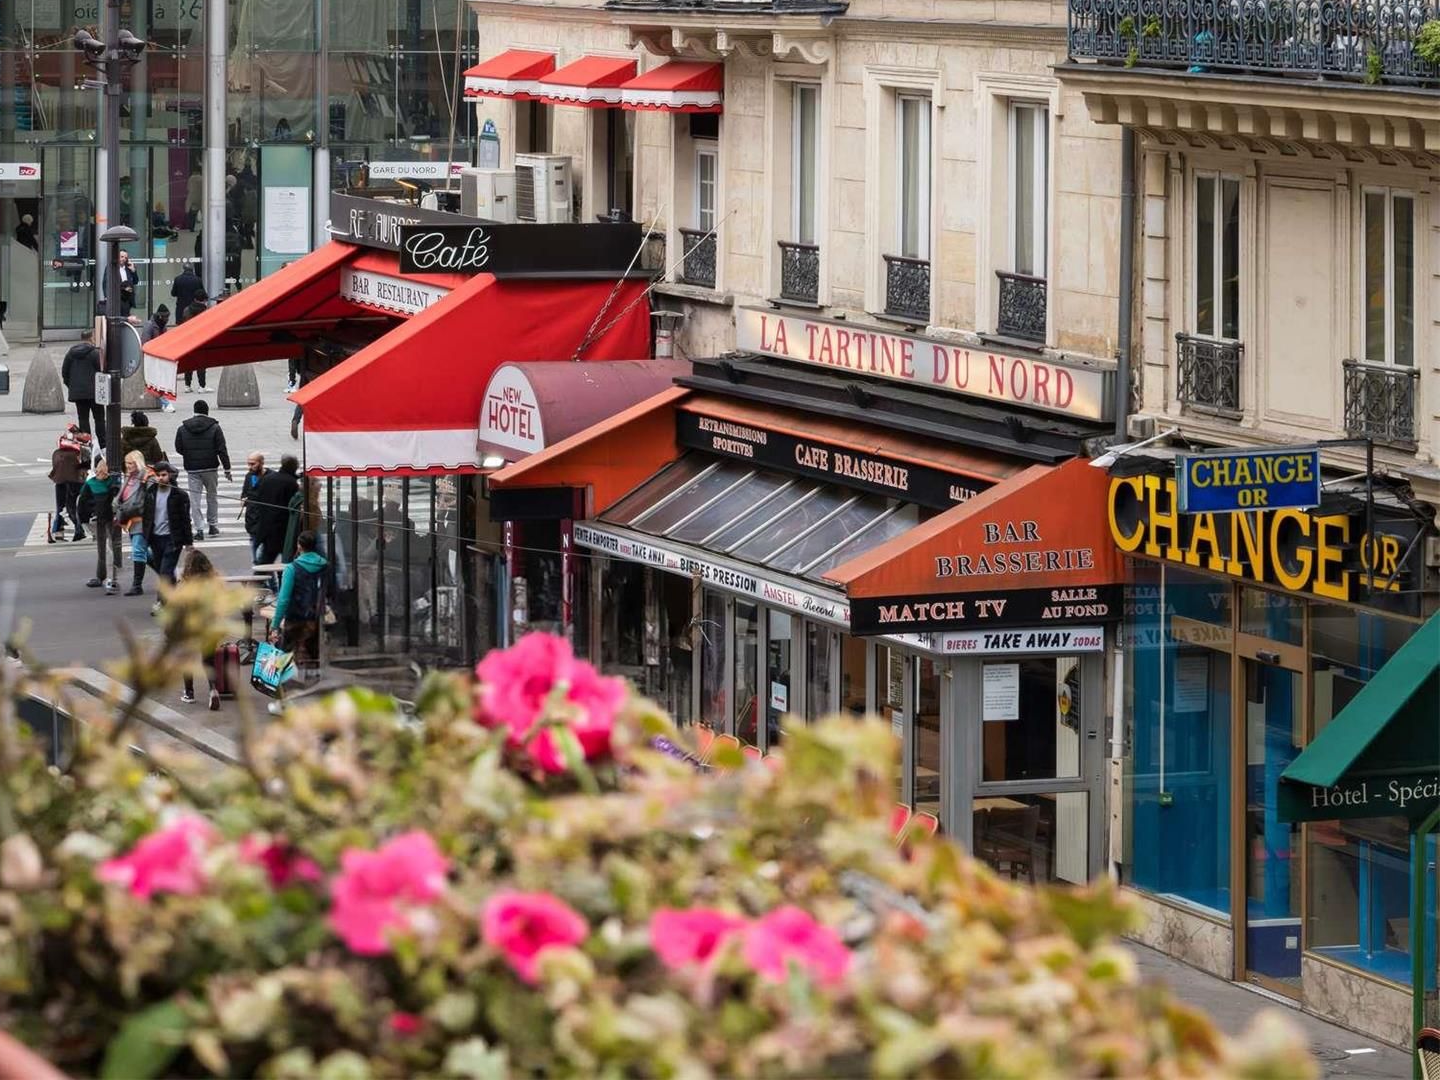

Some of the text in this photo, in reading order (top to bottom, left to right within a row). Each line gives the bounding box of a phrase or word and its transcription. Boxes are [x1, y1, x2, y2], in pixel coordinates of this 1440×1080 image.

[19, 168, 36, 176] SNCF
[373, 166, 395, 174] GARE
[398, 166, 410, 174] DU
[412, 166, 437, 174] NORD
[406, 227, 491, 270] Café
[352, 275, 429, 308] BAR RESTAURANT
[760, 315, 1074, 410] LA TARTINE DU NORD
[503, 386, 522, 405] NEW
[488, 400, 536, 441] HOTEL
[699, 417, 767, 446] RETRANSMISSIONS
[713, 437, 754, 458] SPORTIVES
[795, 443, 909, 491] CAFE BRASSERIE
[1190, 454, 1313, 488] CHANGE
[1238, 488, 1268, 507] OR
[983, 520, 1042, 544] BAR
[1108, 473, 1400, 601] CHANGE OR
[593, 532, 619, 552] EMPORTER
[632, 544, 647, 560] TAKE
[648, 550, 665, 565] AWAY
[713, 569, 757, 593] PRESSION
[763, 583, 798, 607] AMSTEL
[802, 596, 836, 619] Record
[935, 548, 1095, 578] BRASSERIE
[1051, 588, 1097, 602] SALLE
[878, 599, 1007, 623] MATCH TV
[1042, 603, 1109, 619] AU FOND
[946, 632, 1101, 650] BIERES TAKE AWAY SODAS
[1312, 783, 1368, 808] Hôtel
[1388, 777, 1440, 808] Spéci
